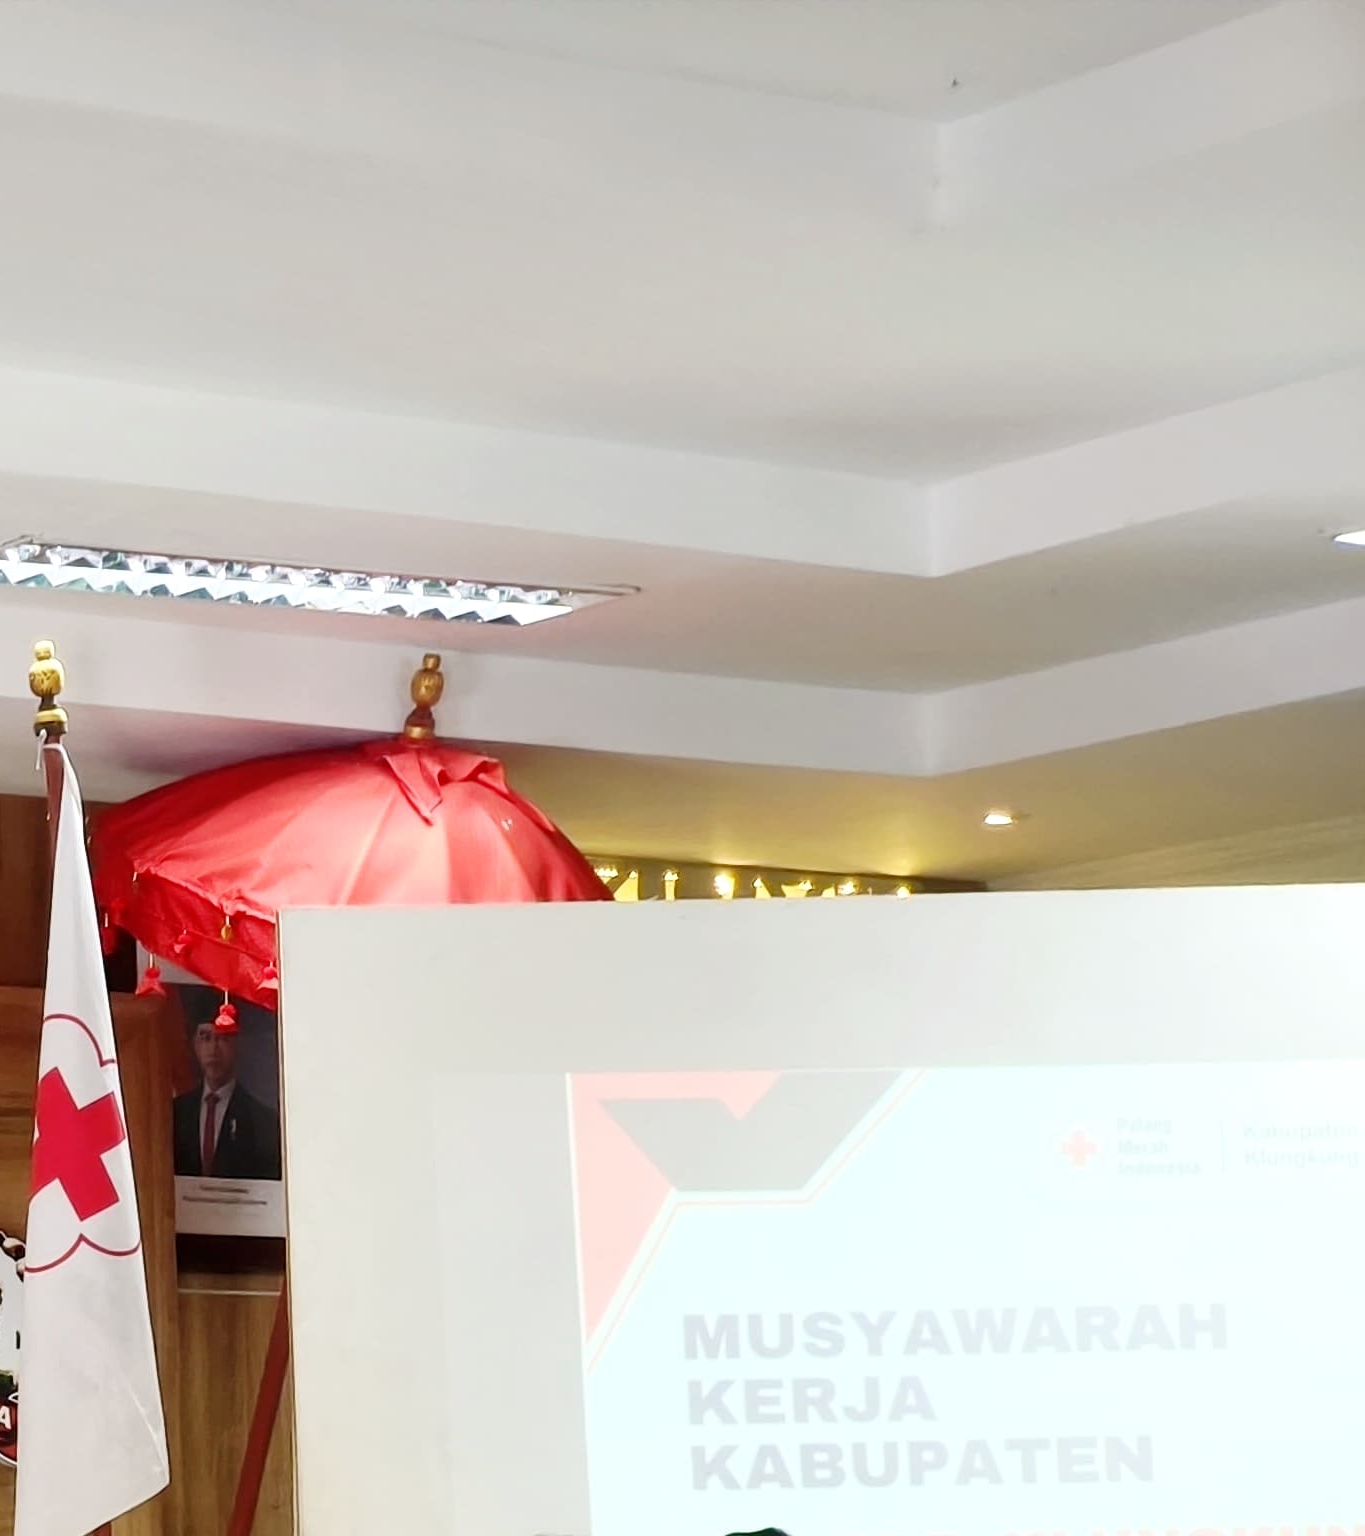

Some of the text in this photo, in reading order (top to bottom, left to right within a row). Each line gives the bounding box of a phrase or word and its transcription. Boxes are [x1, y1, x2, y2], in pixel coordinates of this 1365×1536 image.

[682, 1304, 1229, 1362] MUSYAWARAH
[687, 1376, 938, 1426] KERJA
[690, 1436, 1154, 1491] KABUPATEN
